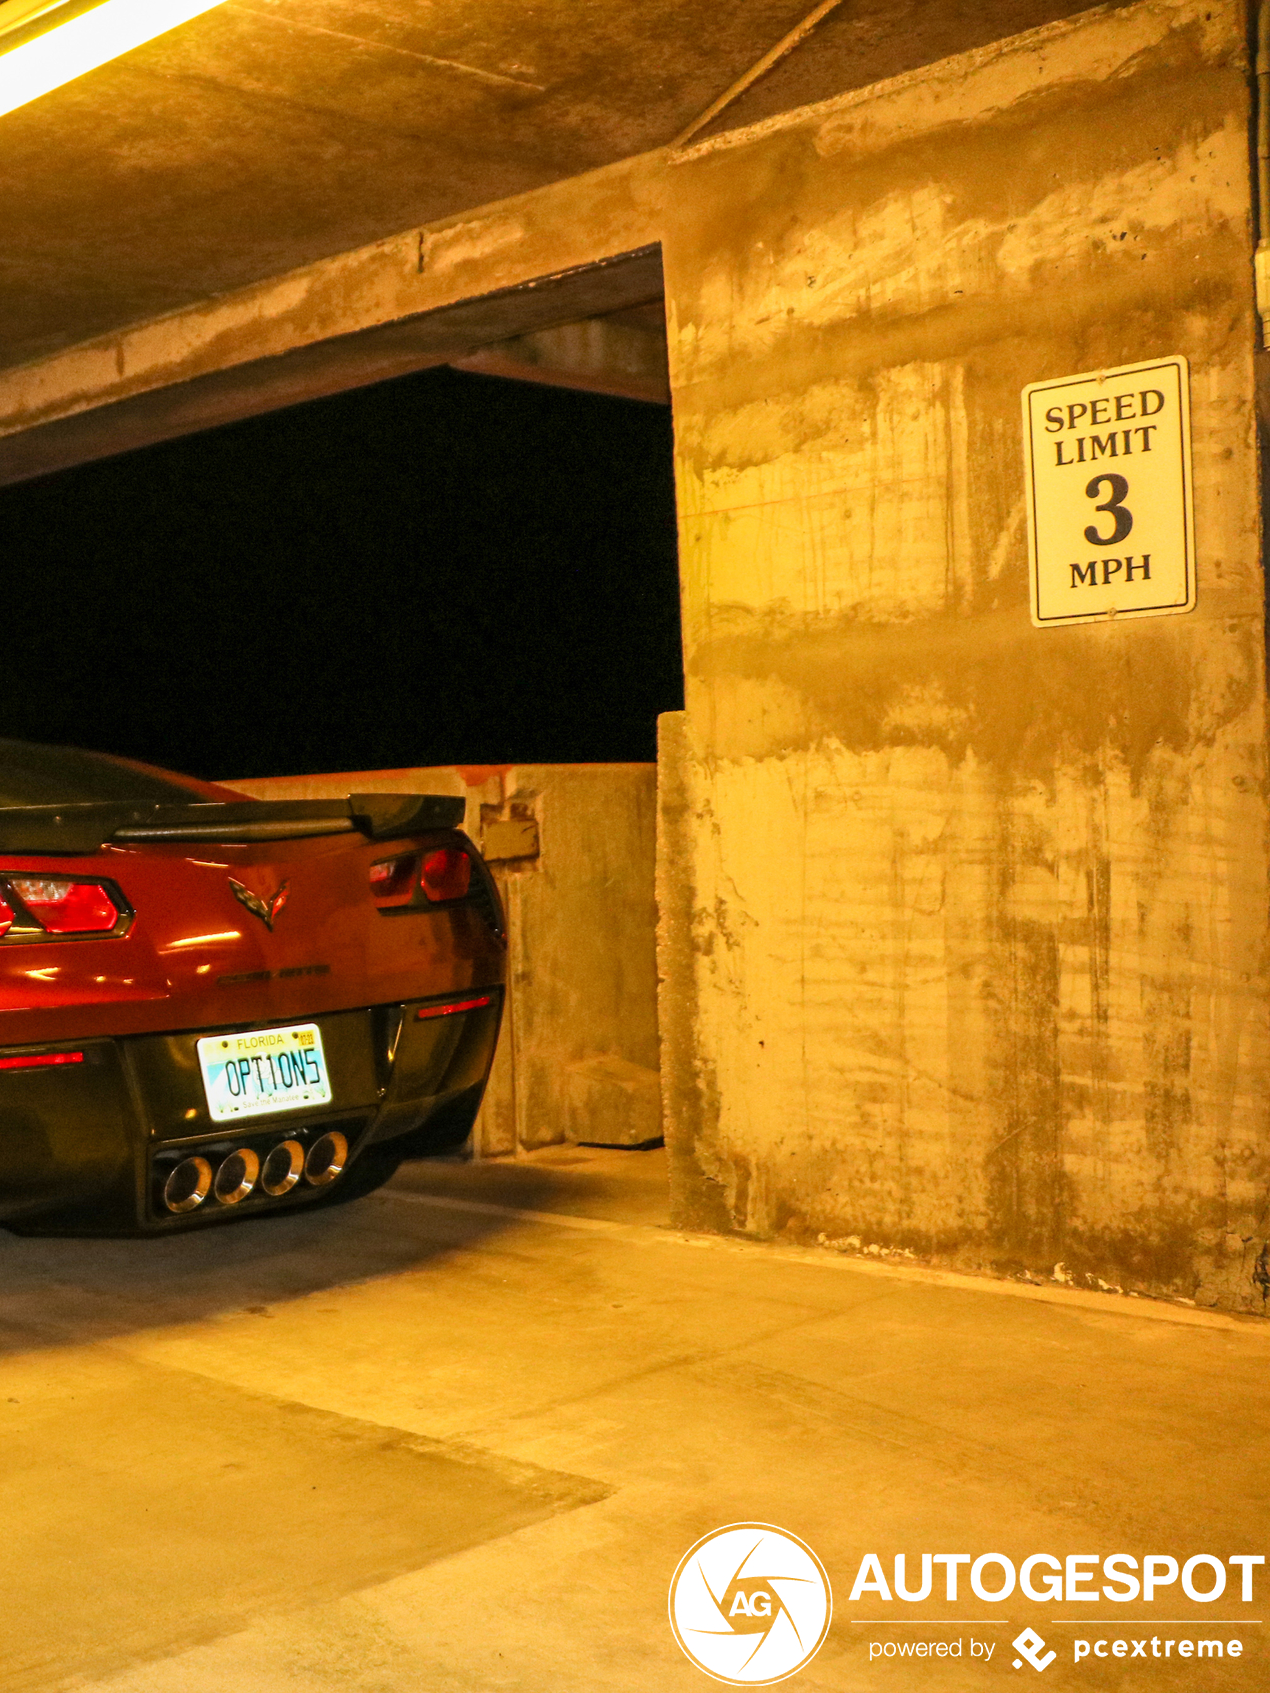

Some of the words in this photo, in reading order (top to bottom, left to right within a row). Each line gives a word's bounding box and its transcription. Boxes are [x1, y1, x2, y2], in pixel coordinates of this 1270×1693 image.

[1045, 388, 1165, 433] SPEED
[1054, 424, 1157, 466] LIMIT
[1083, 472, 1134, 546] 3
[1069, 553, 1152, 589] MPH
[236, 1033, 285, 1050] FLORIDA
